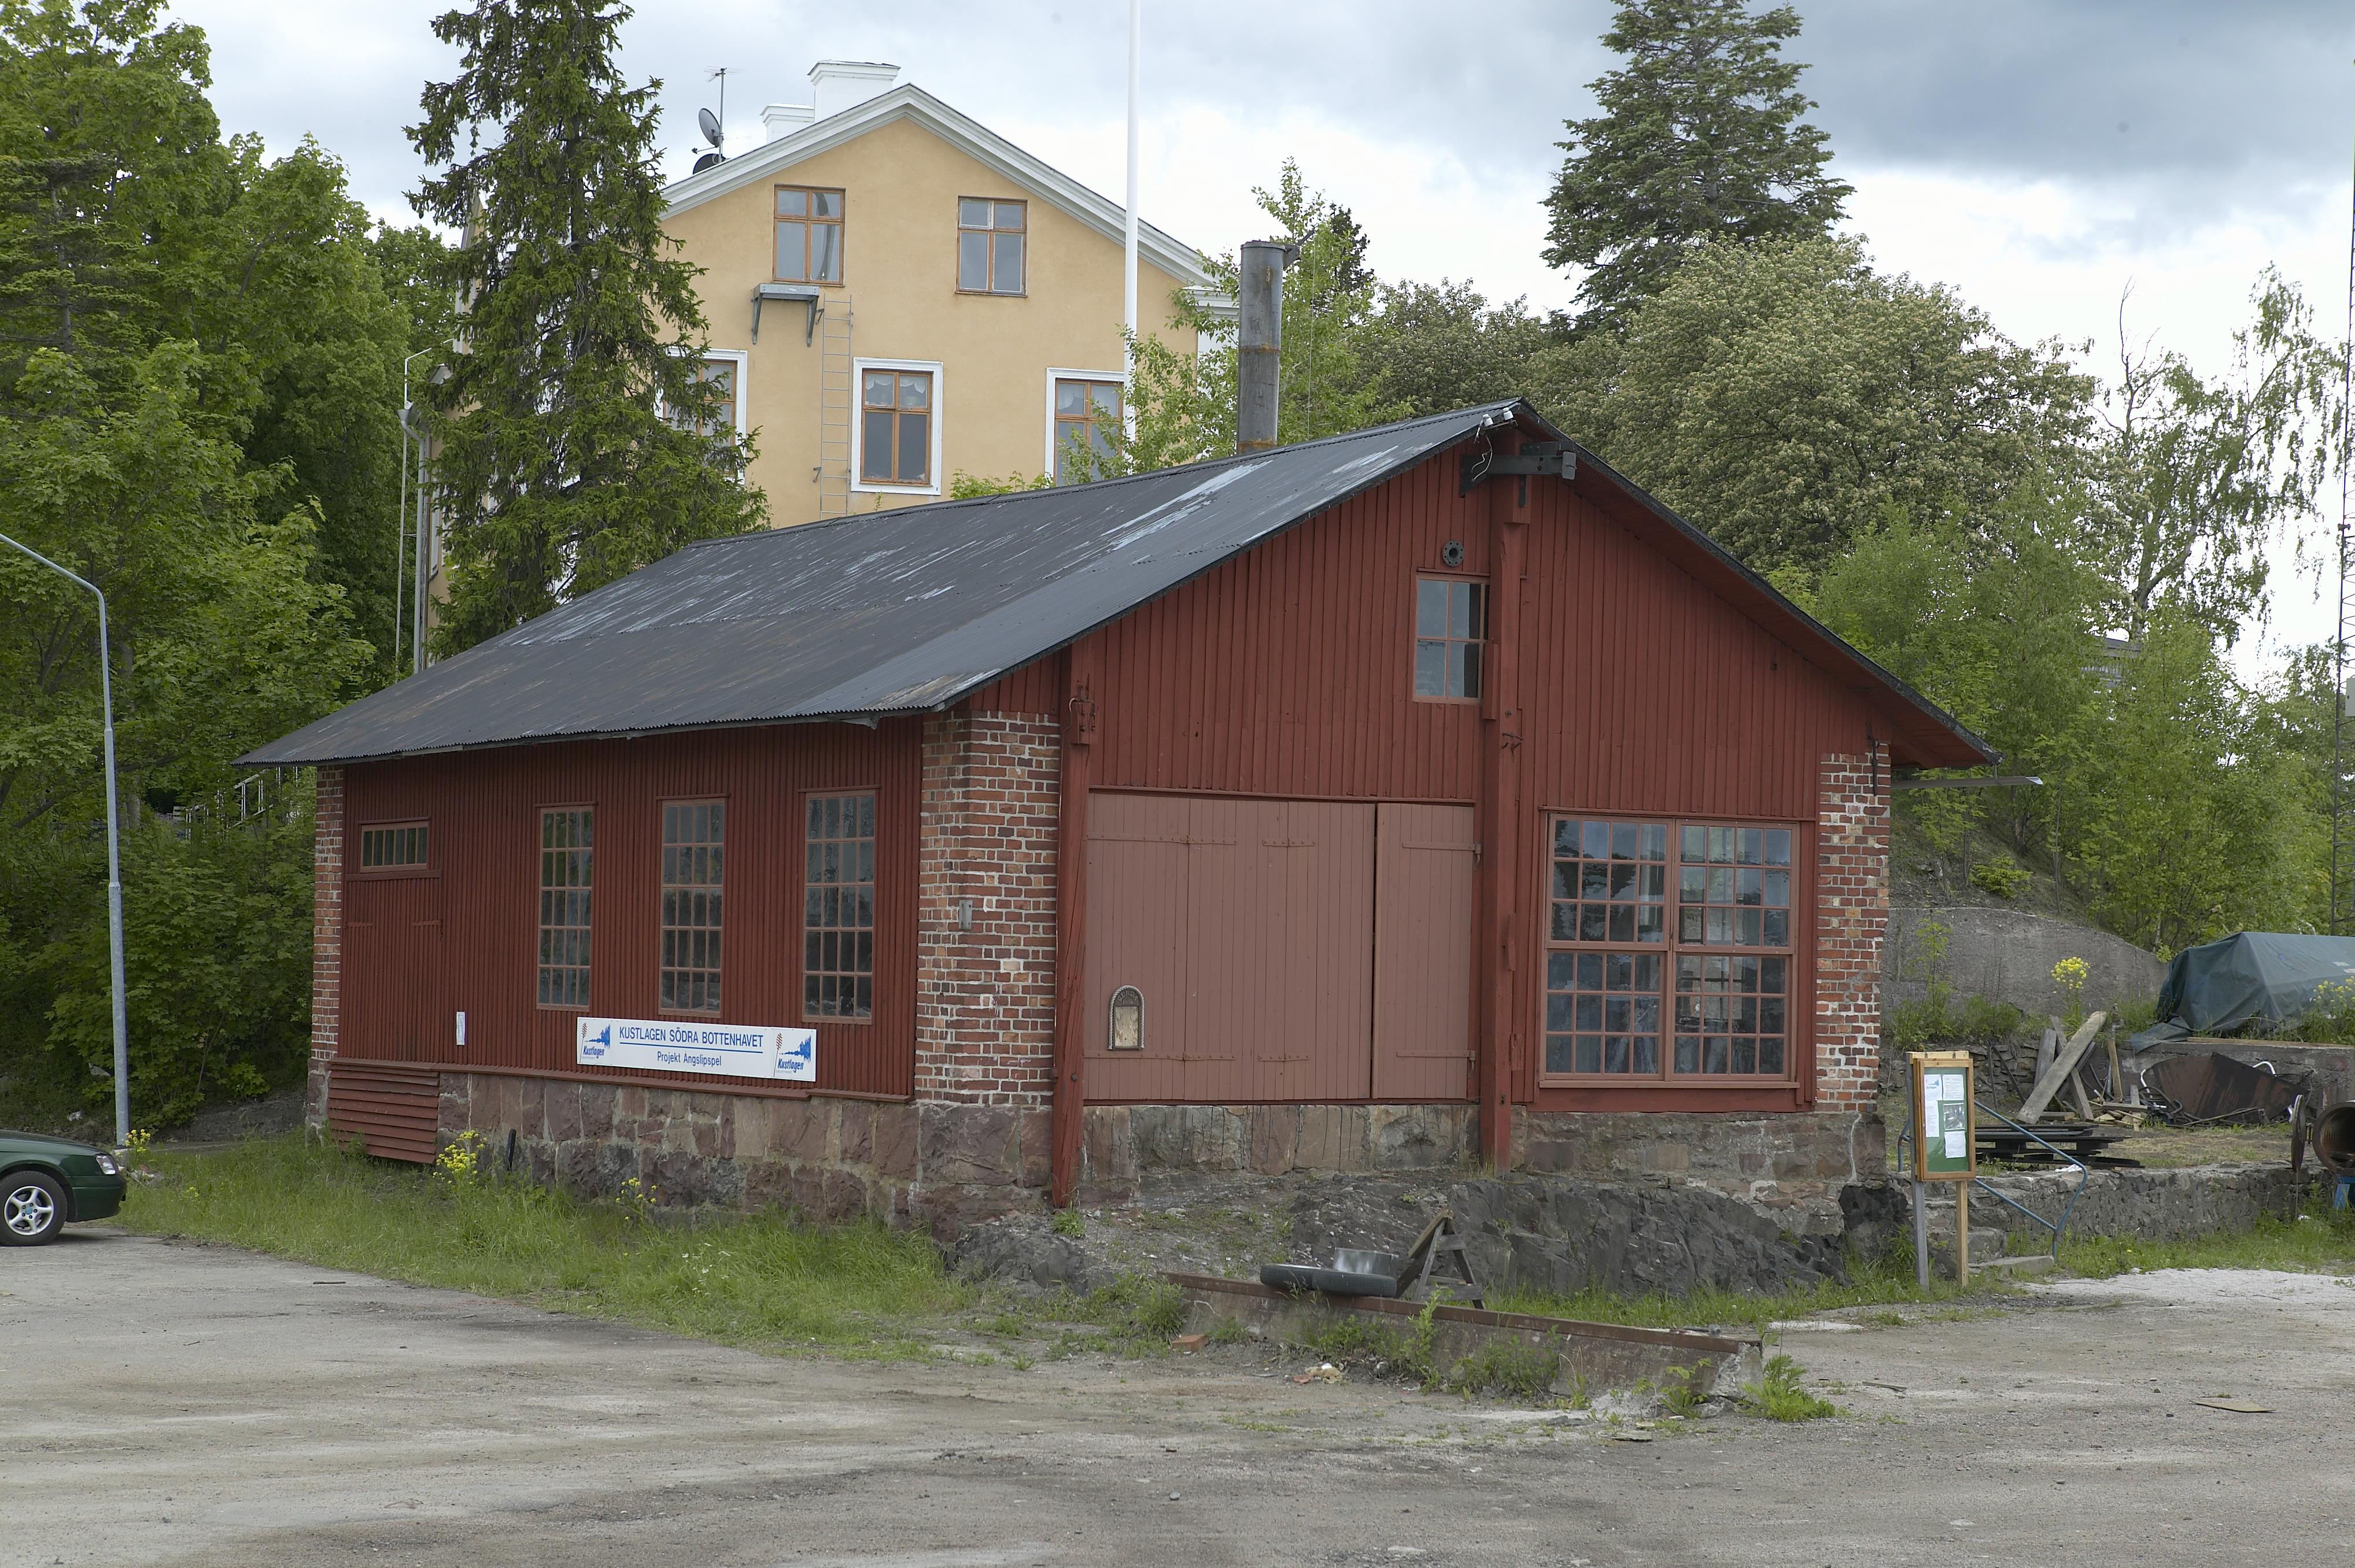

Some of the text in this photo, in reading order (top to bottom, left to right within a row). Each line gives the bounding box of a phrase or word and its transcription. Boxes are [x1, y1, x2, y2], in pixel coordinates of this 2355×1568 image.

[619, 1026, 763, 1047] KUSTLAGEN SÖDRA BOTTENHAVET
[583, 1045, 605, 1059] Kustlagen
[657, 1051, 681, 1064] Projekt
[777, 1058, 804, 1073] Kustlagen
